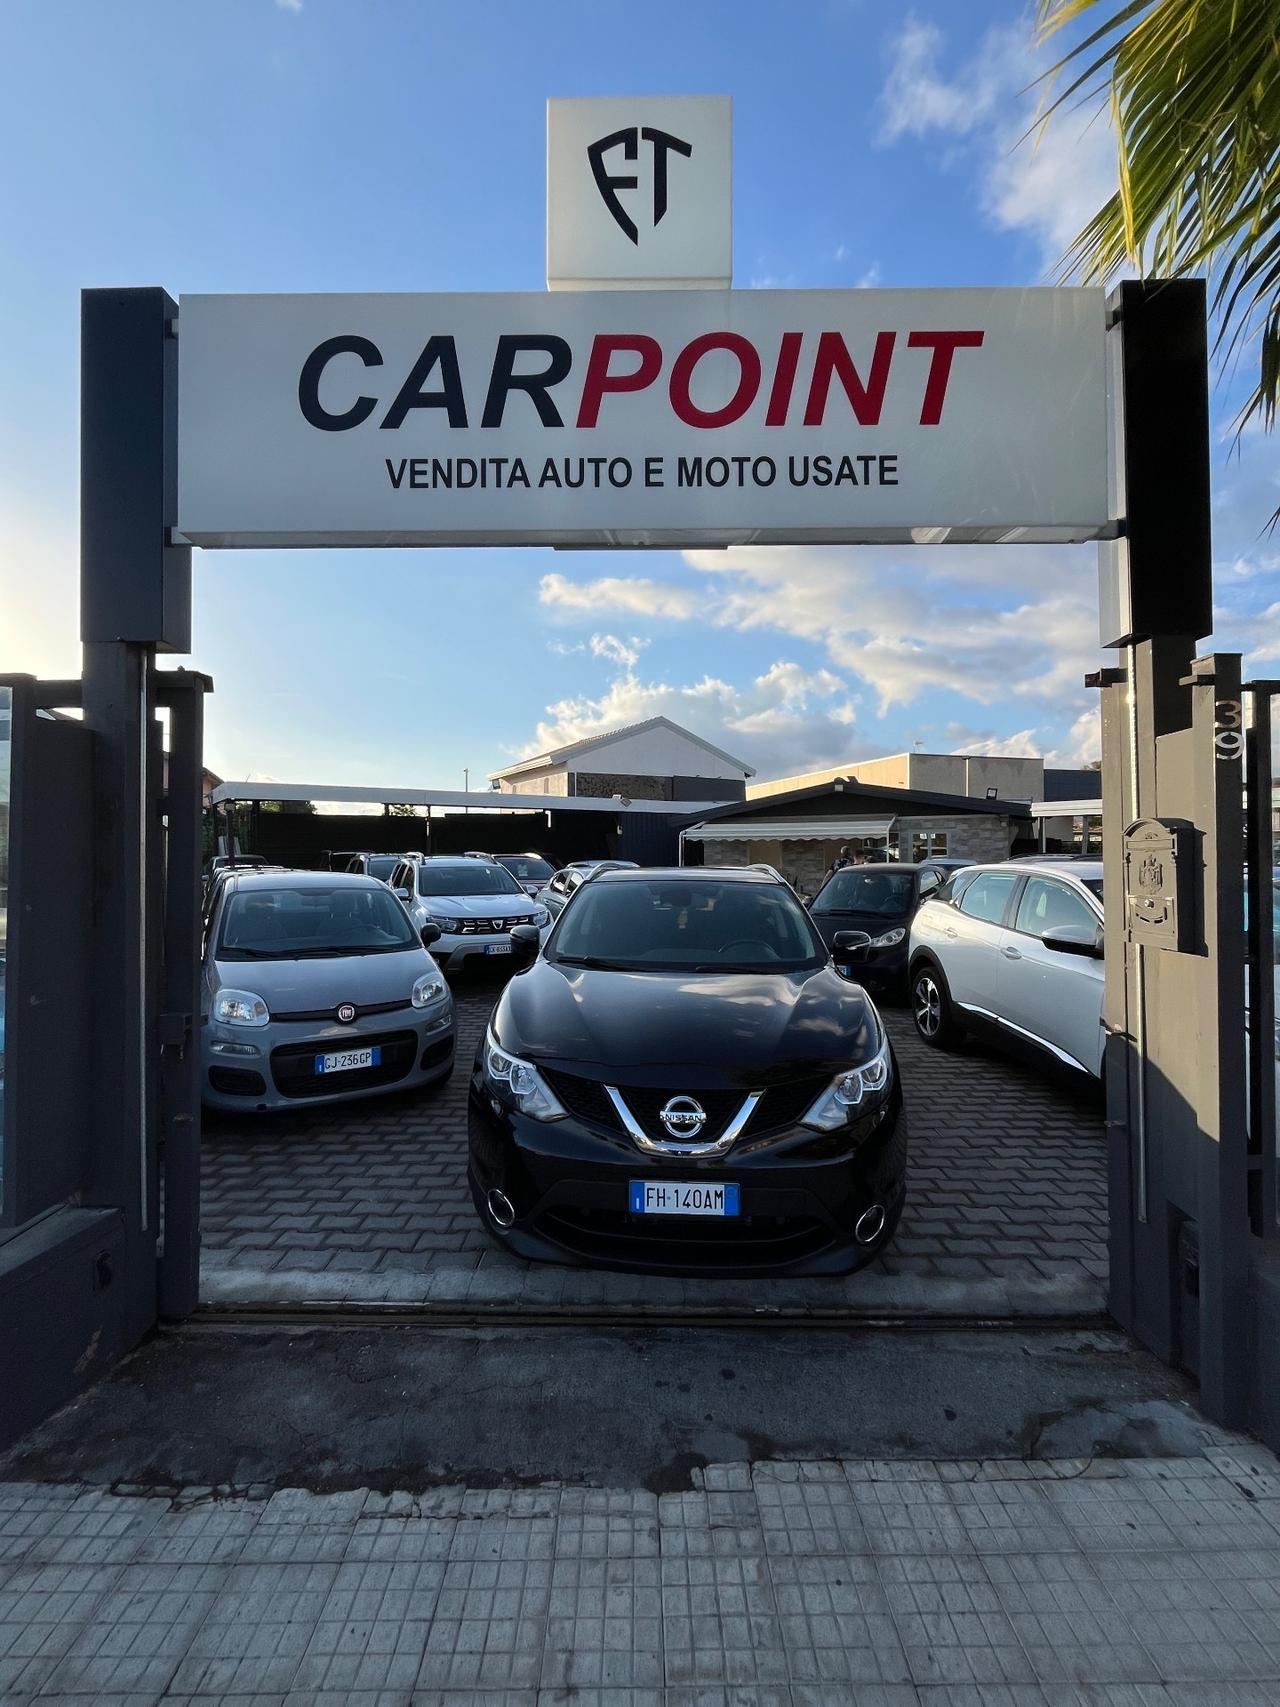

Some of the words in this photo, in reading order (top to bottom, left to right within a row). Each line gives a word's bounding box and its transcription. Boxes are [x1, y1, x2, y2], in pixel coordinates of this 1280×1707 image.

[587, 127, 692, 246] FT
[298, 331, 985, 432] CARPOINT
[386, 458, 530, 489] VENDITA
[538, 457, 633, 489] AUTO
[645, 457, 664, 488] E
[678, 456, 777, 488] MOTO
[788, 455, 899, 487] USATE
[1215, 700, 1245, 760] 39
[664, 1113, 702, 1122] NISSAN
